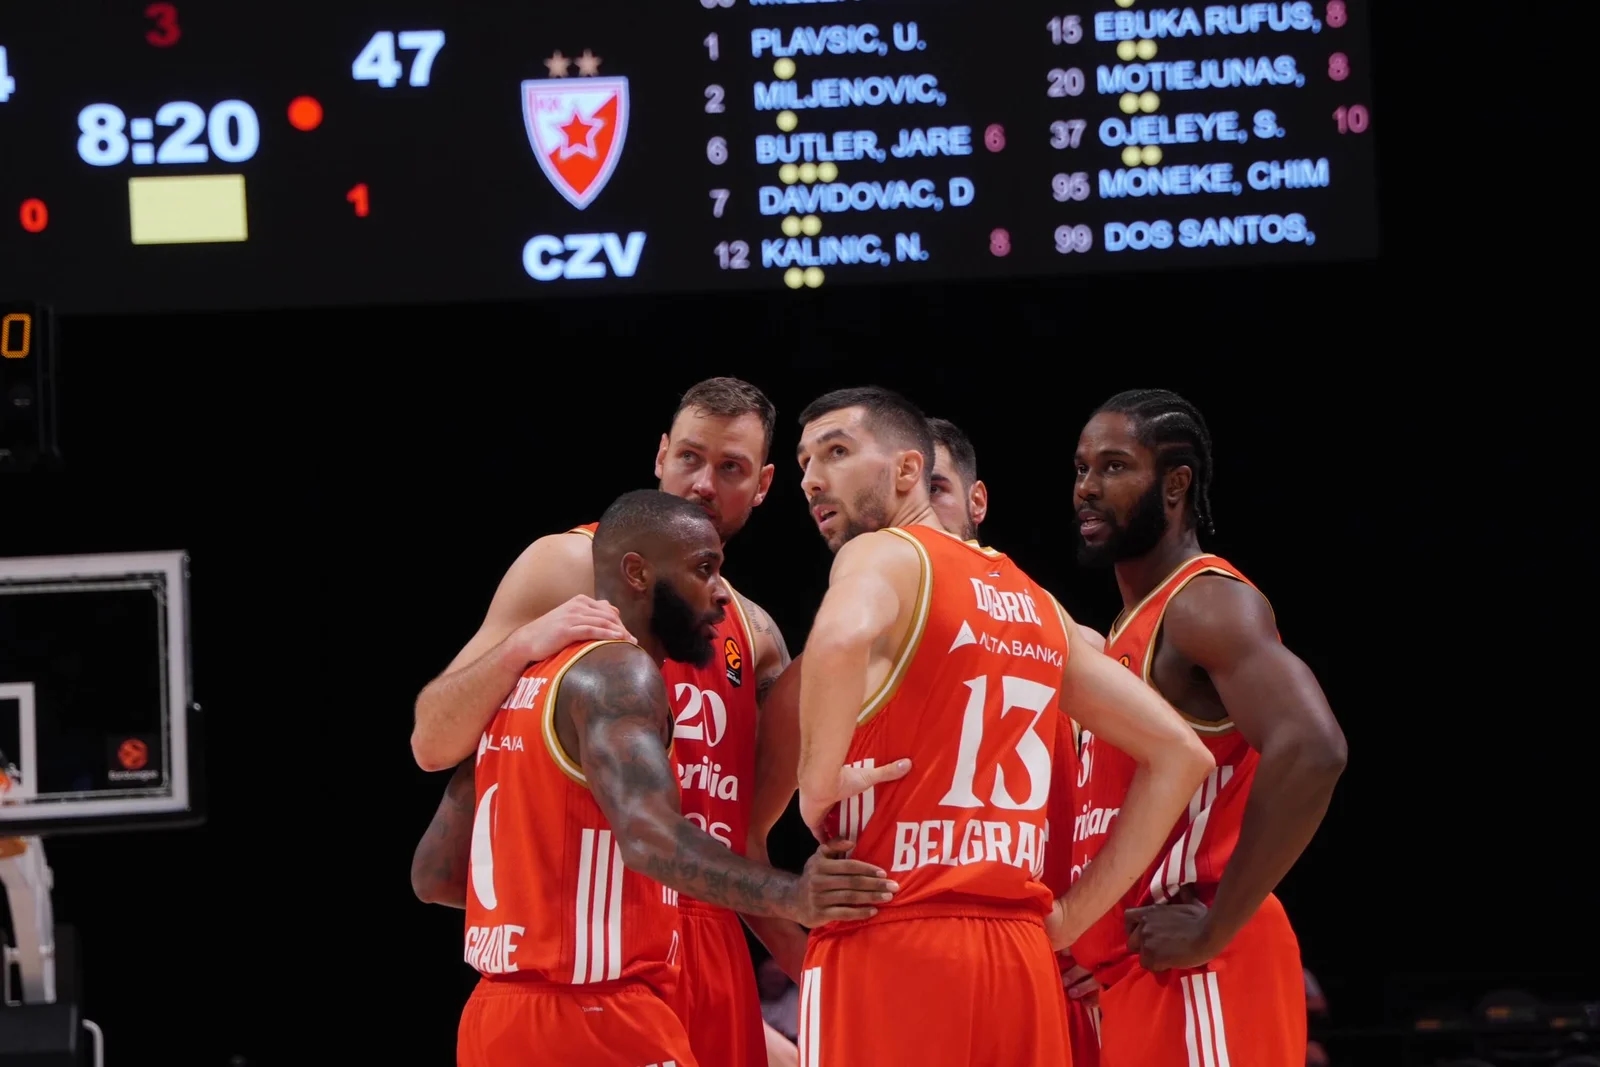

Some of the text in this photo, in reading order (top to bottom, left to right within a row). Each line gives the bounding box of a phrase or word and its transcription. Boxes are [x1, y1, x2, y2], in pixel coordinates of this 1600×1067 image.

[146, 3, 181, 46] 3
[703, 21, 927, 61] 1 PLAVSIC, U.
[1047, 0, 1347, 44] 15 EBUKA RUFUS, 8
[352, 30, 446, 88] 47
[1047, 52, 1349, 97] 20 MOTIEJUNAS, 8
[704, 74, 947, 113] 2 MILJENOVIC,
[77, 99, 260, 166] 8:20
[706, 123, 1006, 165] 6 BUTLER, JARE 6
[1049, 104, 1369, 149] 37 OJELEYE, S. 10
[346, 183, 369, 217] 1
[709, 177, 975, 218] 7 DAVIDOVAC, D
[1051, 157, 1330, 202] 95 MONEKE, CHIM
[19, 197, 49, 233] 0
[1054, 213, 1316, 253] 99 DOS SANTOS,
[522, 231, 647, 281] CZV
[714, 228, 1011, 269] 12 KALINIC, N. 8
[674, 683, 726, 747] 20
[938, 675, 1067, 811] 13
